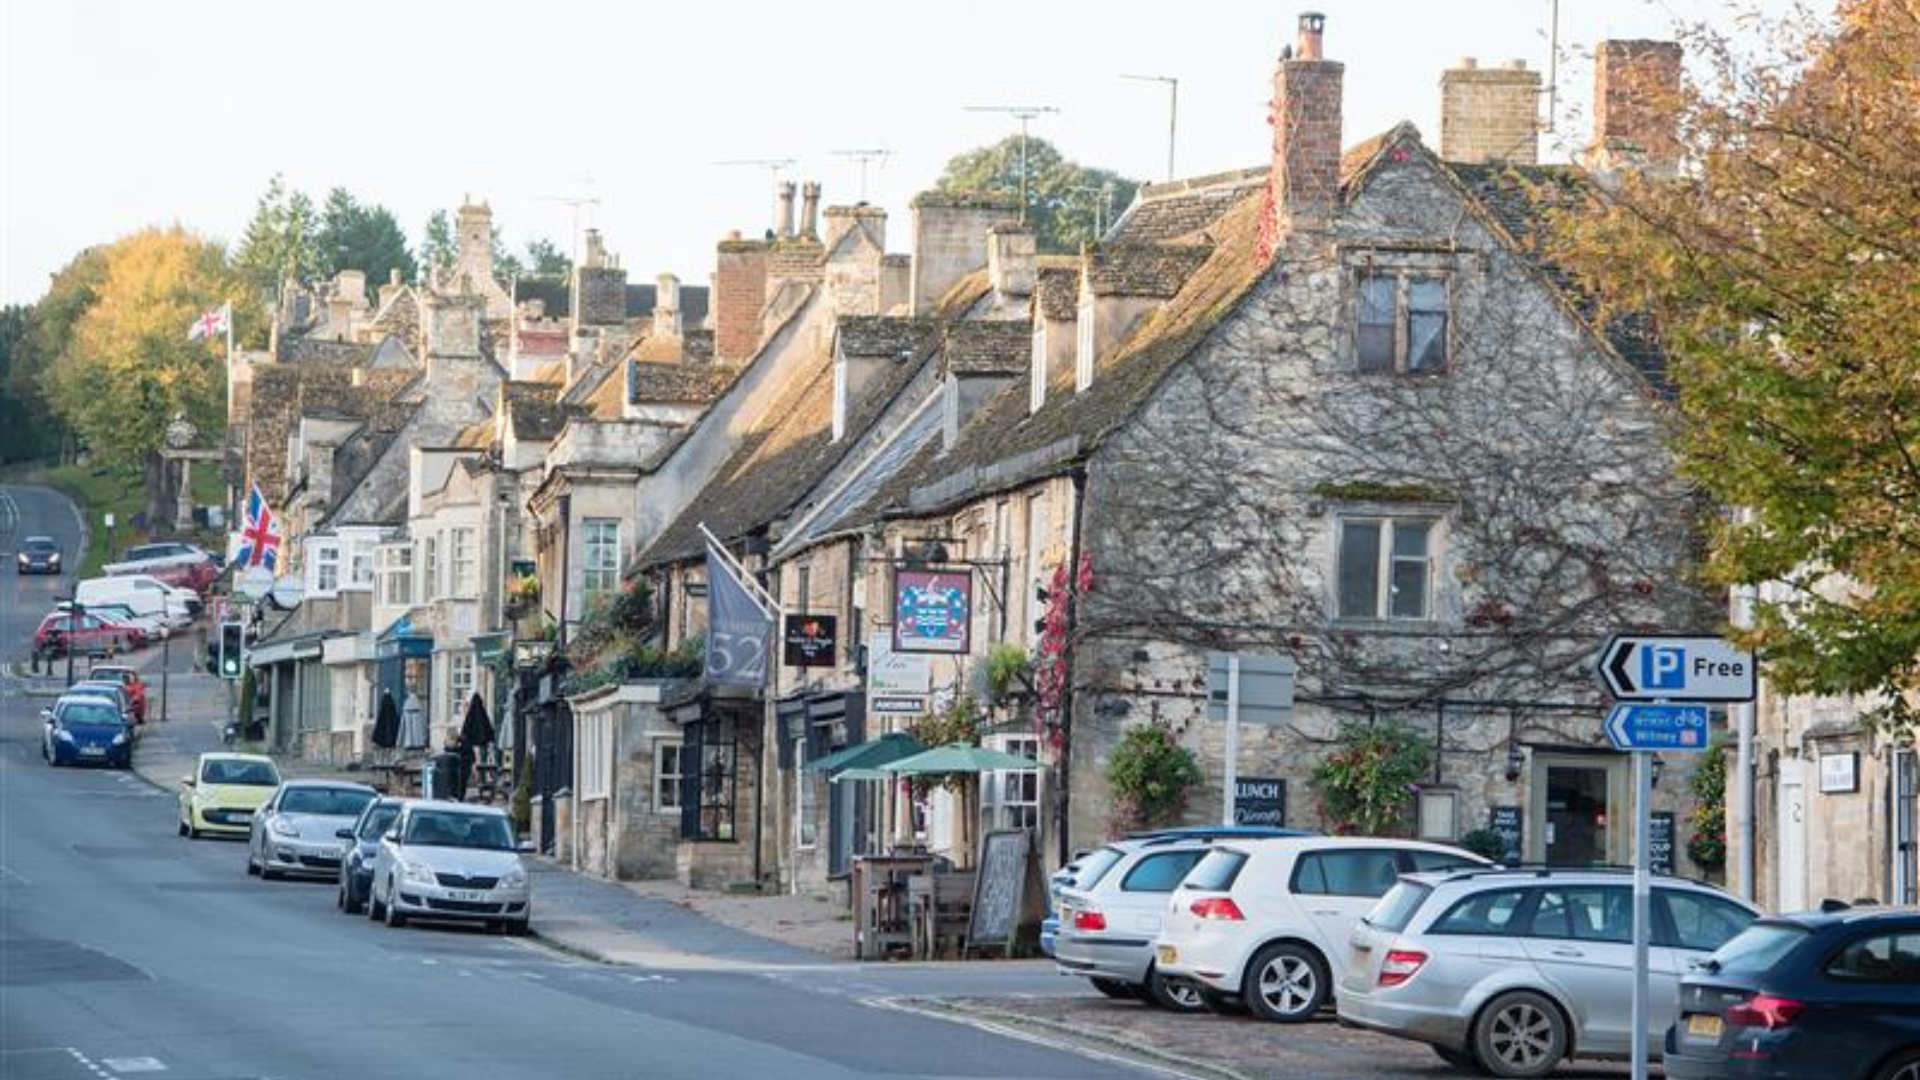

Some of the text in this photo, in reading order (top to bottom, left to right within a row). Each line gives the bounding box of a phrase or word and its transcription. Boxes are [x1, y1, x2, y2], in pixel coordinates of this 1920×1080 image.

[707, 632, 764, 676] 52
[1653, 651, 1743, 686] P Free
[1636, 730, 1676, 743] Witney
[1235, 783, 1278, 799] LUNCH
